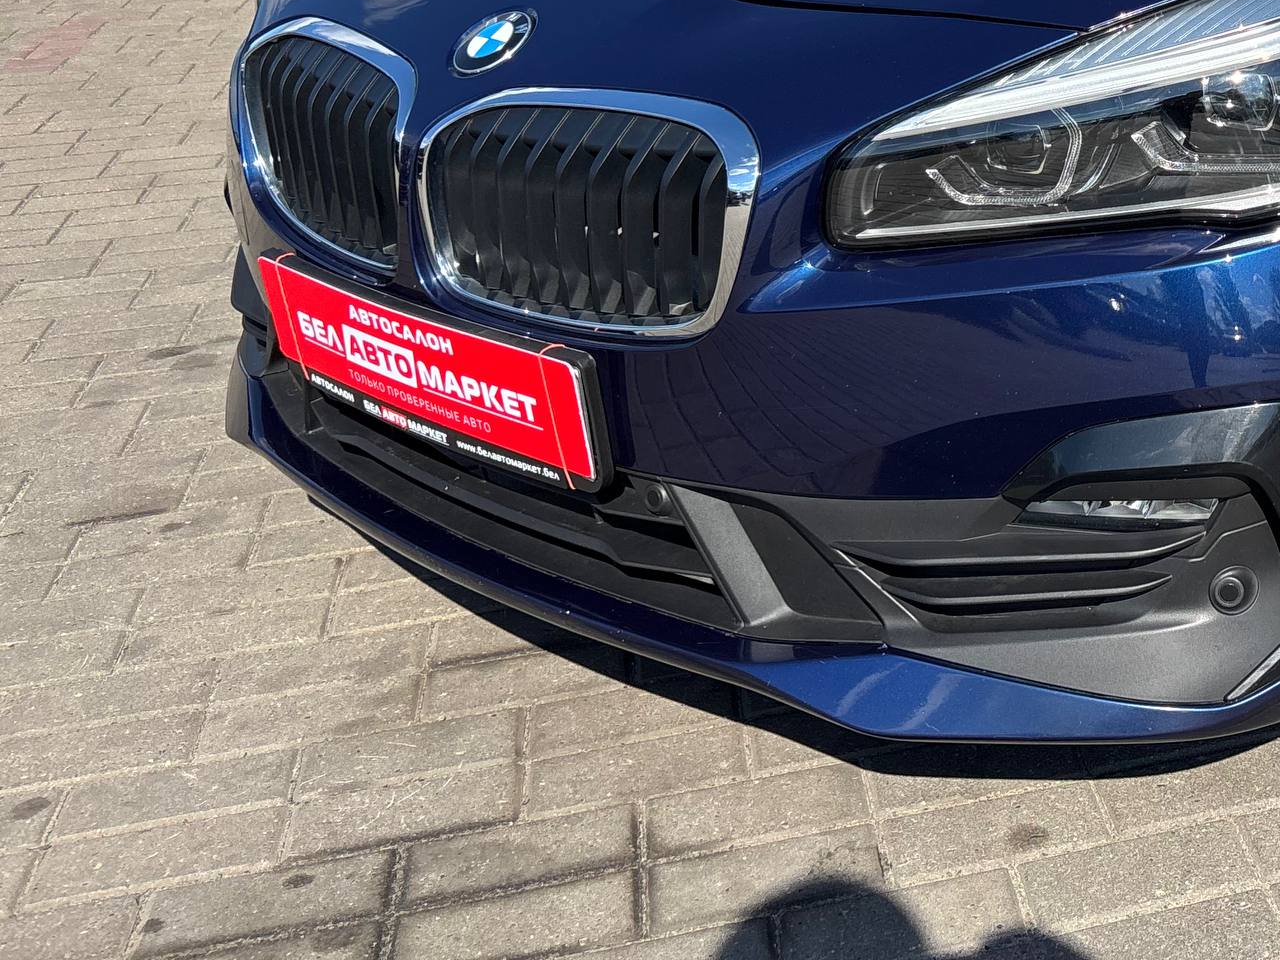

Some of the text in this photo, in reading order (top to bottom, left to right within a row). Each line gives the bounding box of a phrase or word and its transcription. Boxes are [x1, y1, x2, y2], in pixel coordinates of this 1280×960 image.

[348, 304, 454, 356] АВТОСАЛОН
[311, 372, 355, 404] АВТОСАЛОН
[348, 368, 492, 434] ТОЛЬКО ПРОВЕРЕННЫЕ АВТО
